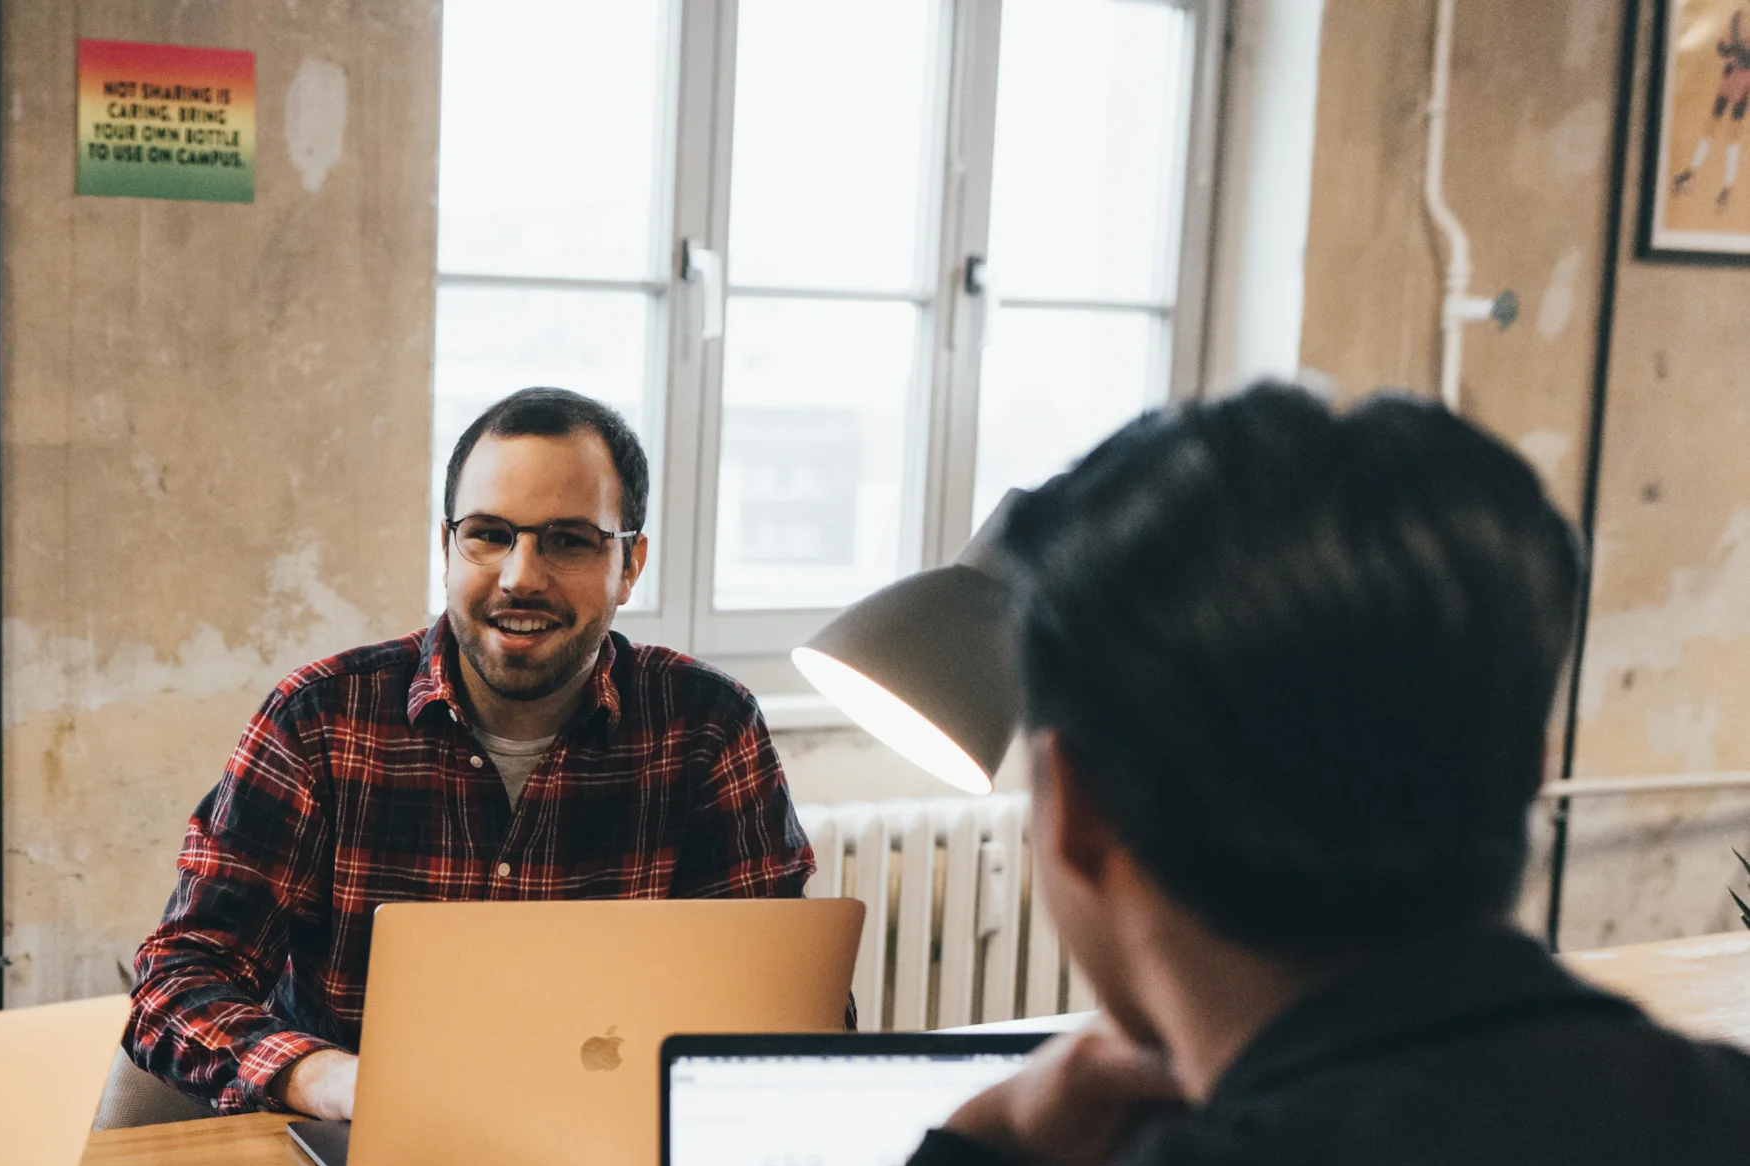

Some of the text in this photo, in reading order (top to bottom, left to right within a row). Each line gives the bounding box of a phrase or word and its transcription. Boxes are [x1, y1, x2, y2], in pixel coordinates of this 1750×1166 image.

[103, 81, 231, 105] NOT SHARING IS
[178, 107, 226, 125] BRING
[94, 122, 239, 146] YOUR OWN BOTTLE
[88, 142, 110, 161] TO
[113, 145, 143, 163] USE
[148, 147, 172, 164] ON
